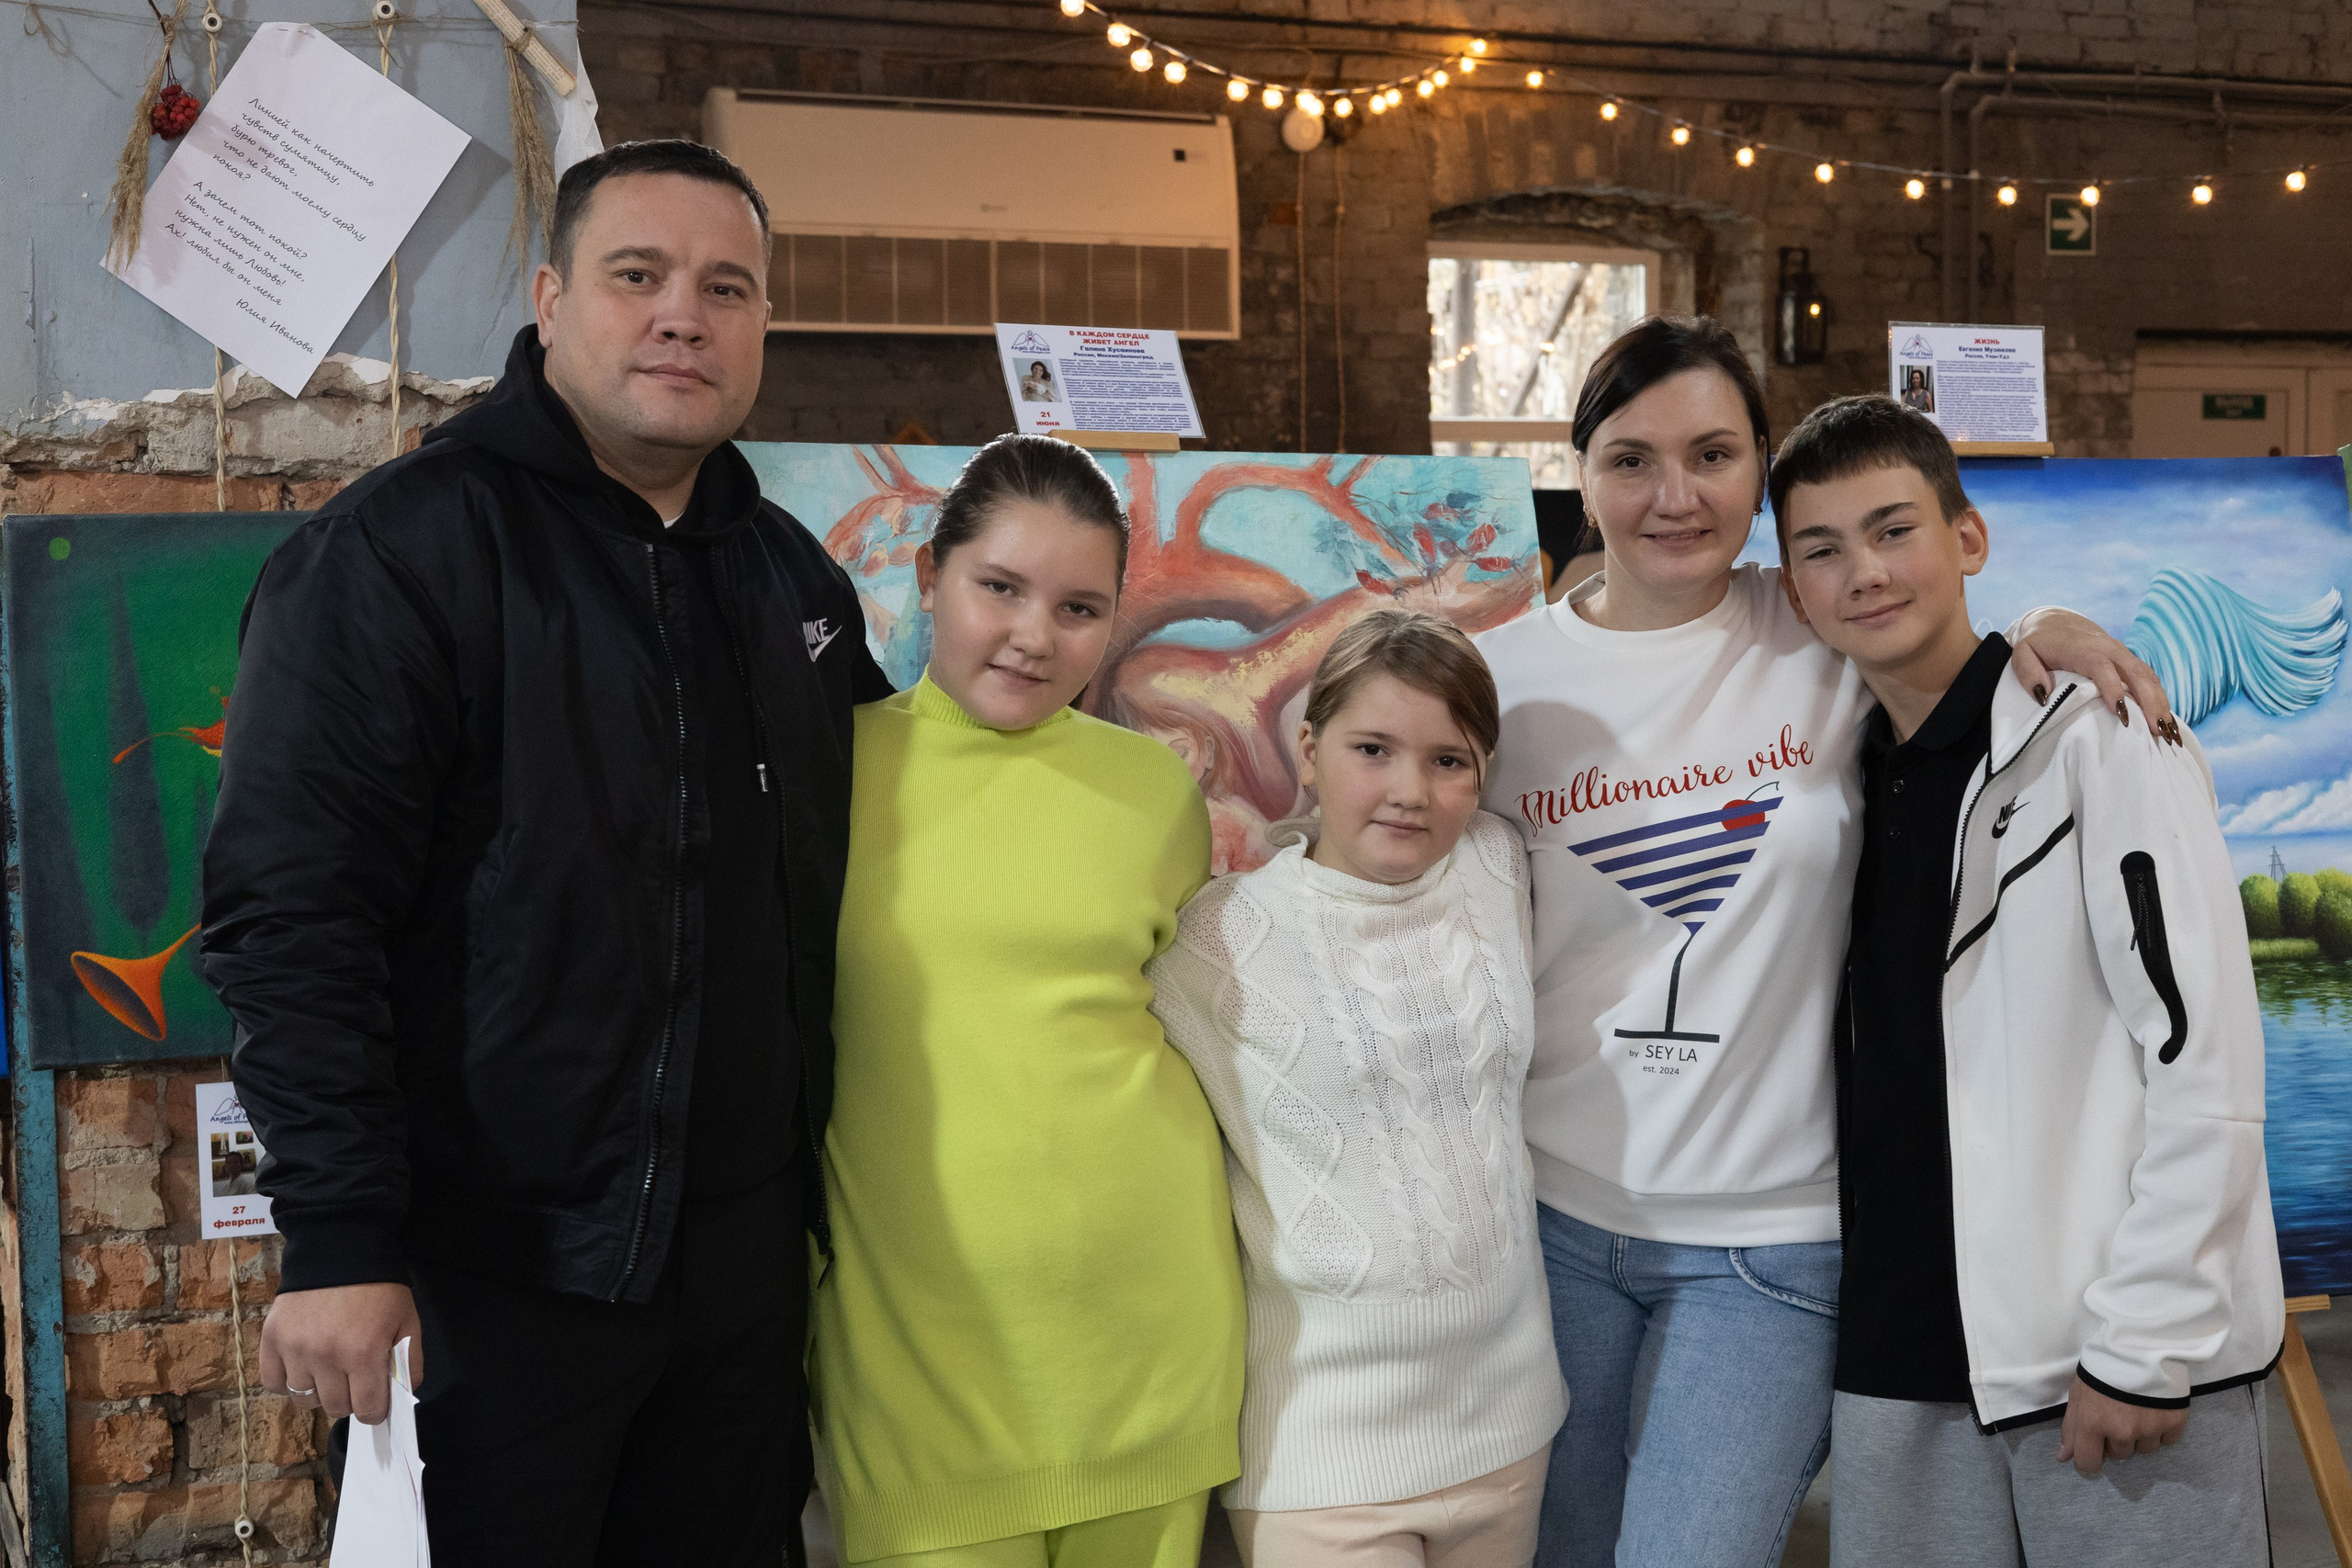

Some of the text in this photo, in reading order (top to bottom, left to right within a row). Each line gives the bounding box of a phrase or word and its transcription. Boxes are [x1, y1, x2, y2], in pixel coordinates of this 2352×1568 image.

[212, 153, 252, 181] покоя?
[231, 124, 298, 177] бурю тревог,
[242, 112, 340, 186] чувств сумятицу,
[247, 97, 375, 187] Линией как начертить
[192, 181, 308, 260] А зачем тот покой?
[223, 140, 368, 243] что не дают моему сердцу
[164, 222, 282, 306] Ах! любил бы он меня
[175, 209, 287, 288] нужна лишь Любовь!
[184, 193, 305, 283] Нет, не нужен он мне,
[235, 298, 314, 355] Юлия Иванова
[1514, 724, 1815, 837] Millionaire vibe
[1629, 1049, 1639, 1057] by
[1643, 1066, 1679, 1075] est. 2024
[210, 1114, 232, 1123] Angels
[213, 1217, 266, 1229] февраля
[232, 1205, 245, 1214] 27
